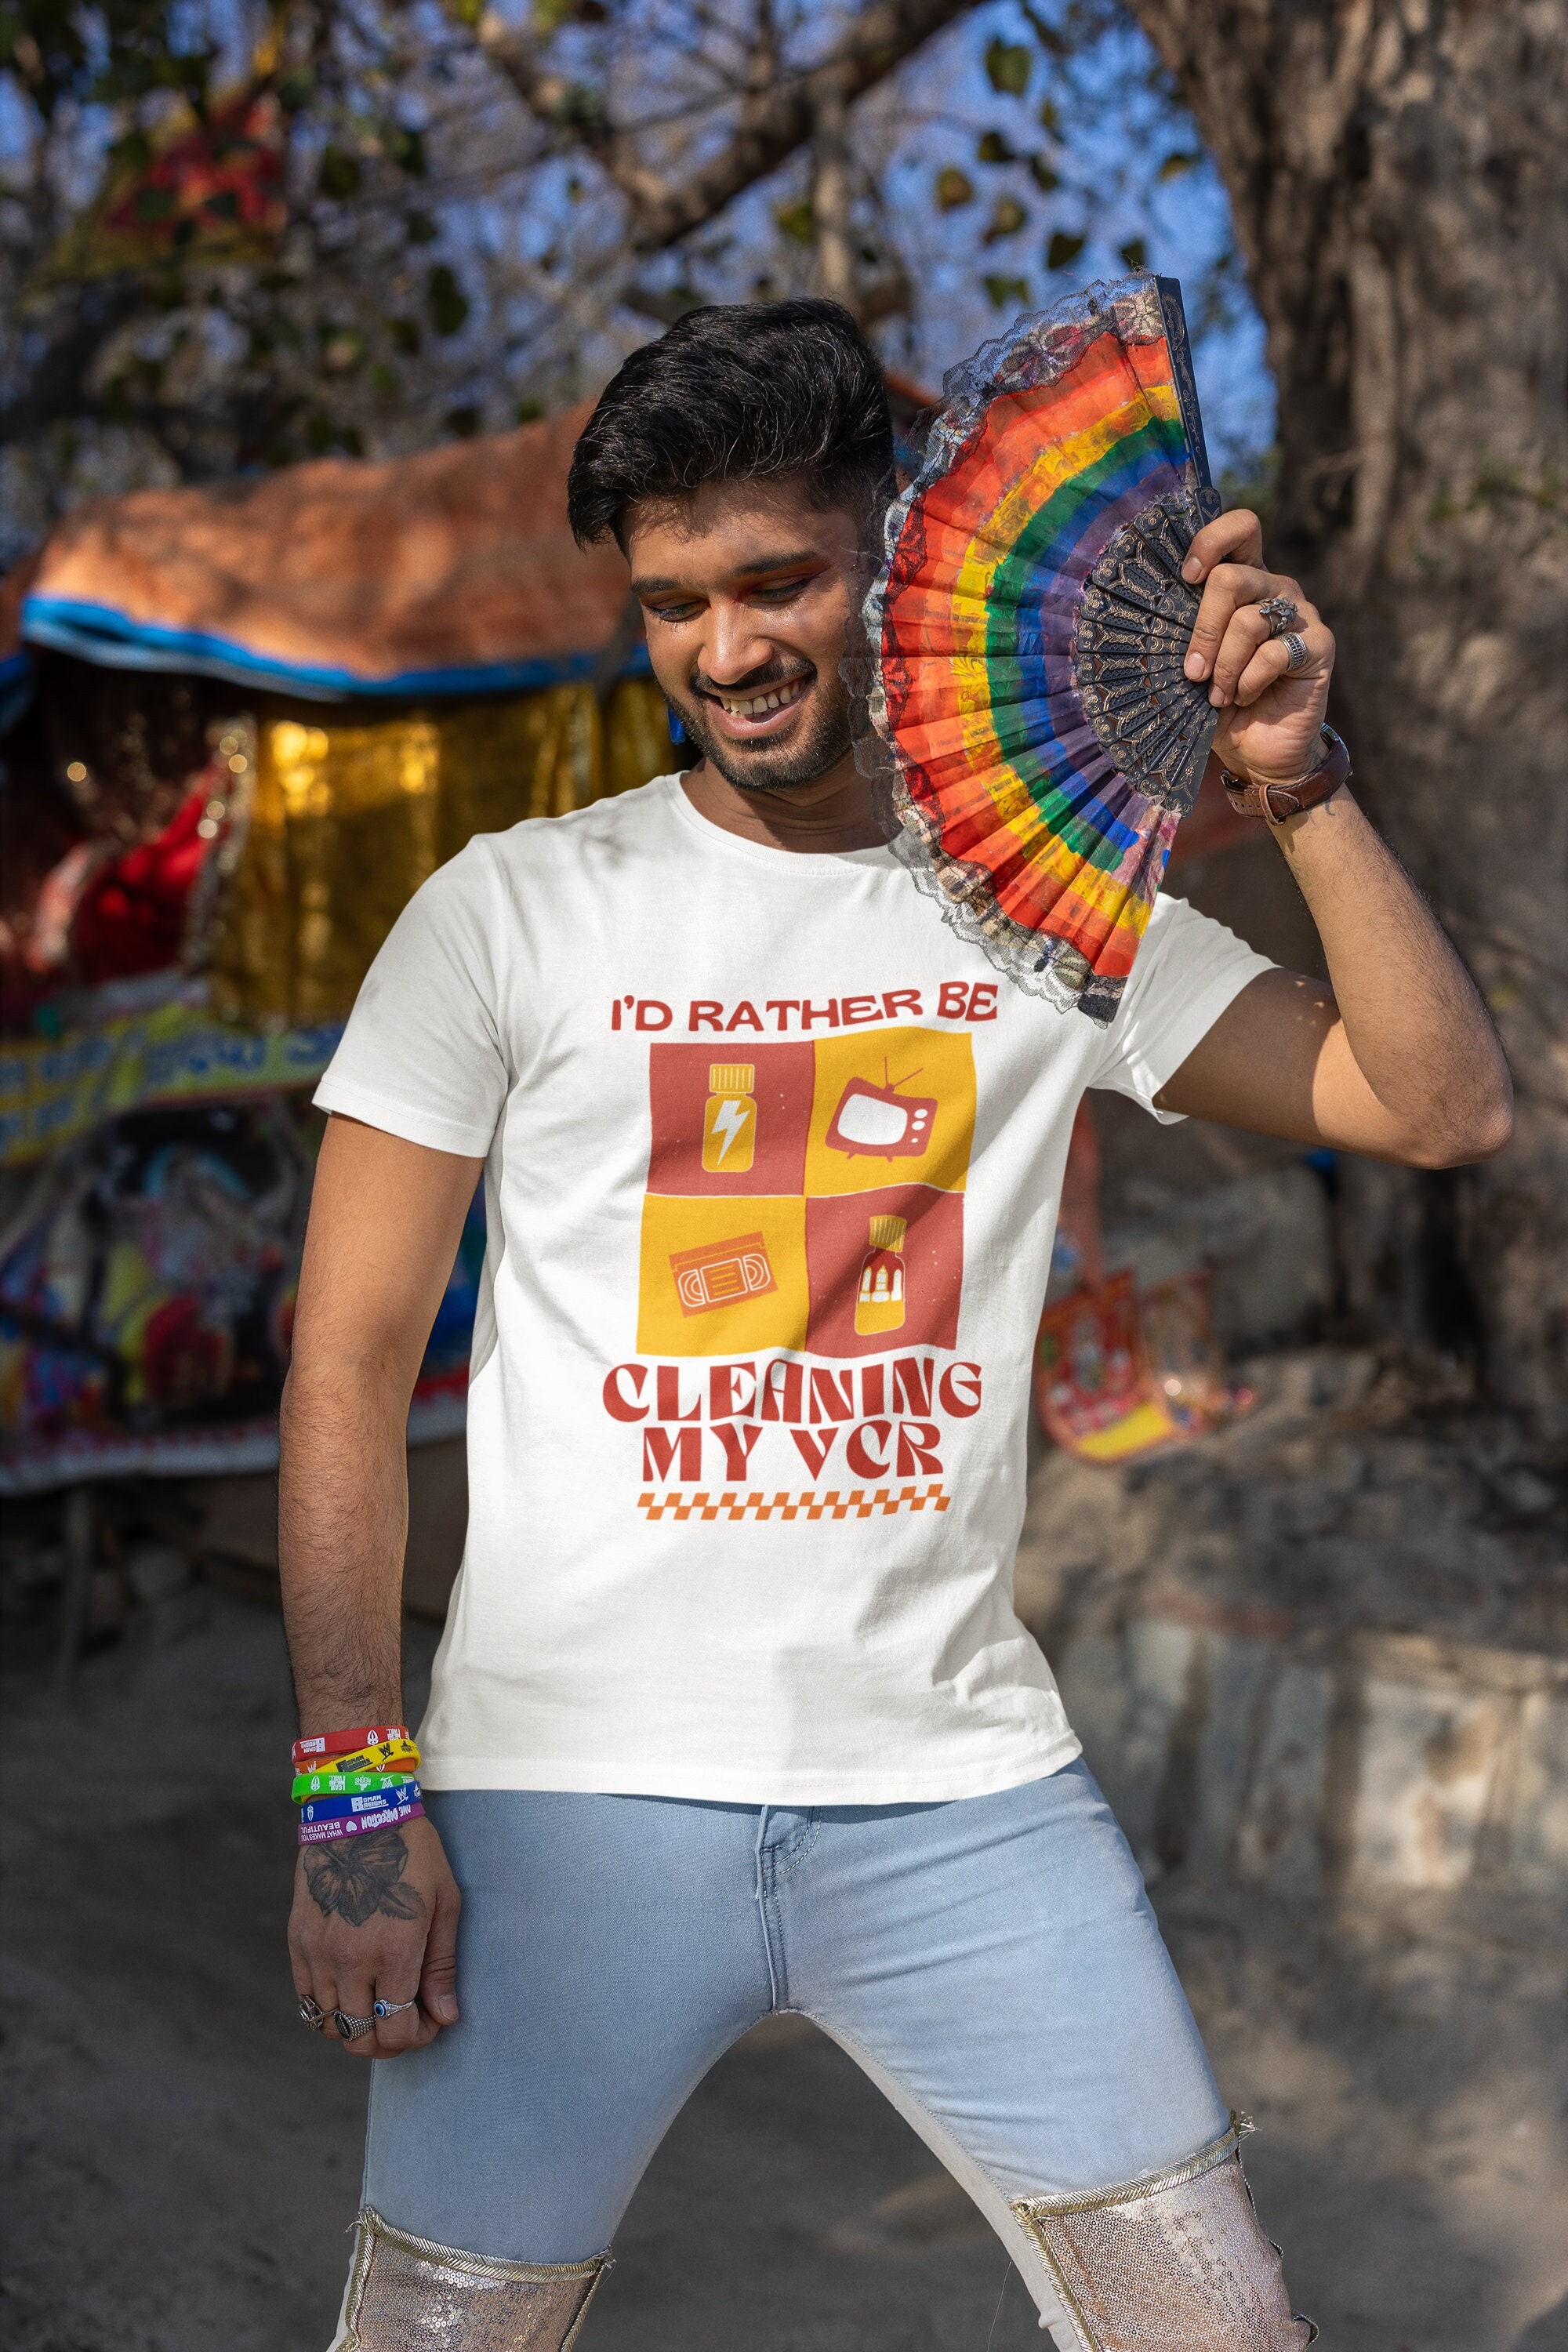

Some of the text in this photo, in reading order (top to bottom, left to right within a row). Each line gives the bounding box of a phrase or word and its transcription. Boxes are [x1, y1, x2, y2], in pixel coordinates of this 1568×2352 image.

[611, 981, 998, 1032] I'D RATHER BE
[602, 1357, 982, 1425] CLEANING
[642, 1419, 944, 1482] MY VCR
[300, 1821, 341, 1833] BEAUTIFUL
[361, 1804, 412, 1830] ONE DIRECTION
[309, 1831, 326, 1840] MAKES
[326, 1828, 343, 1838] WHAT
